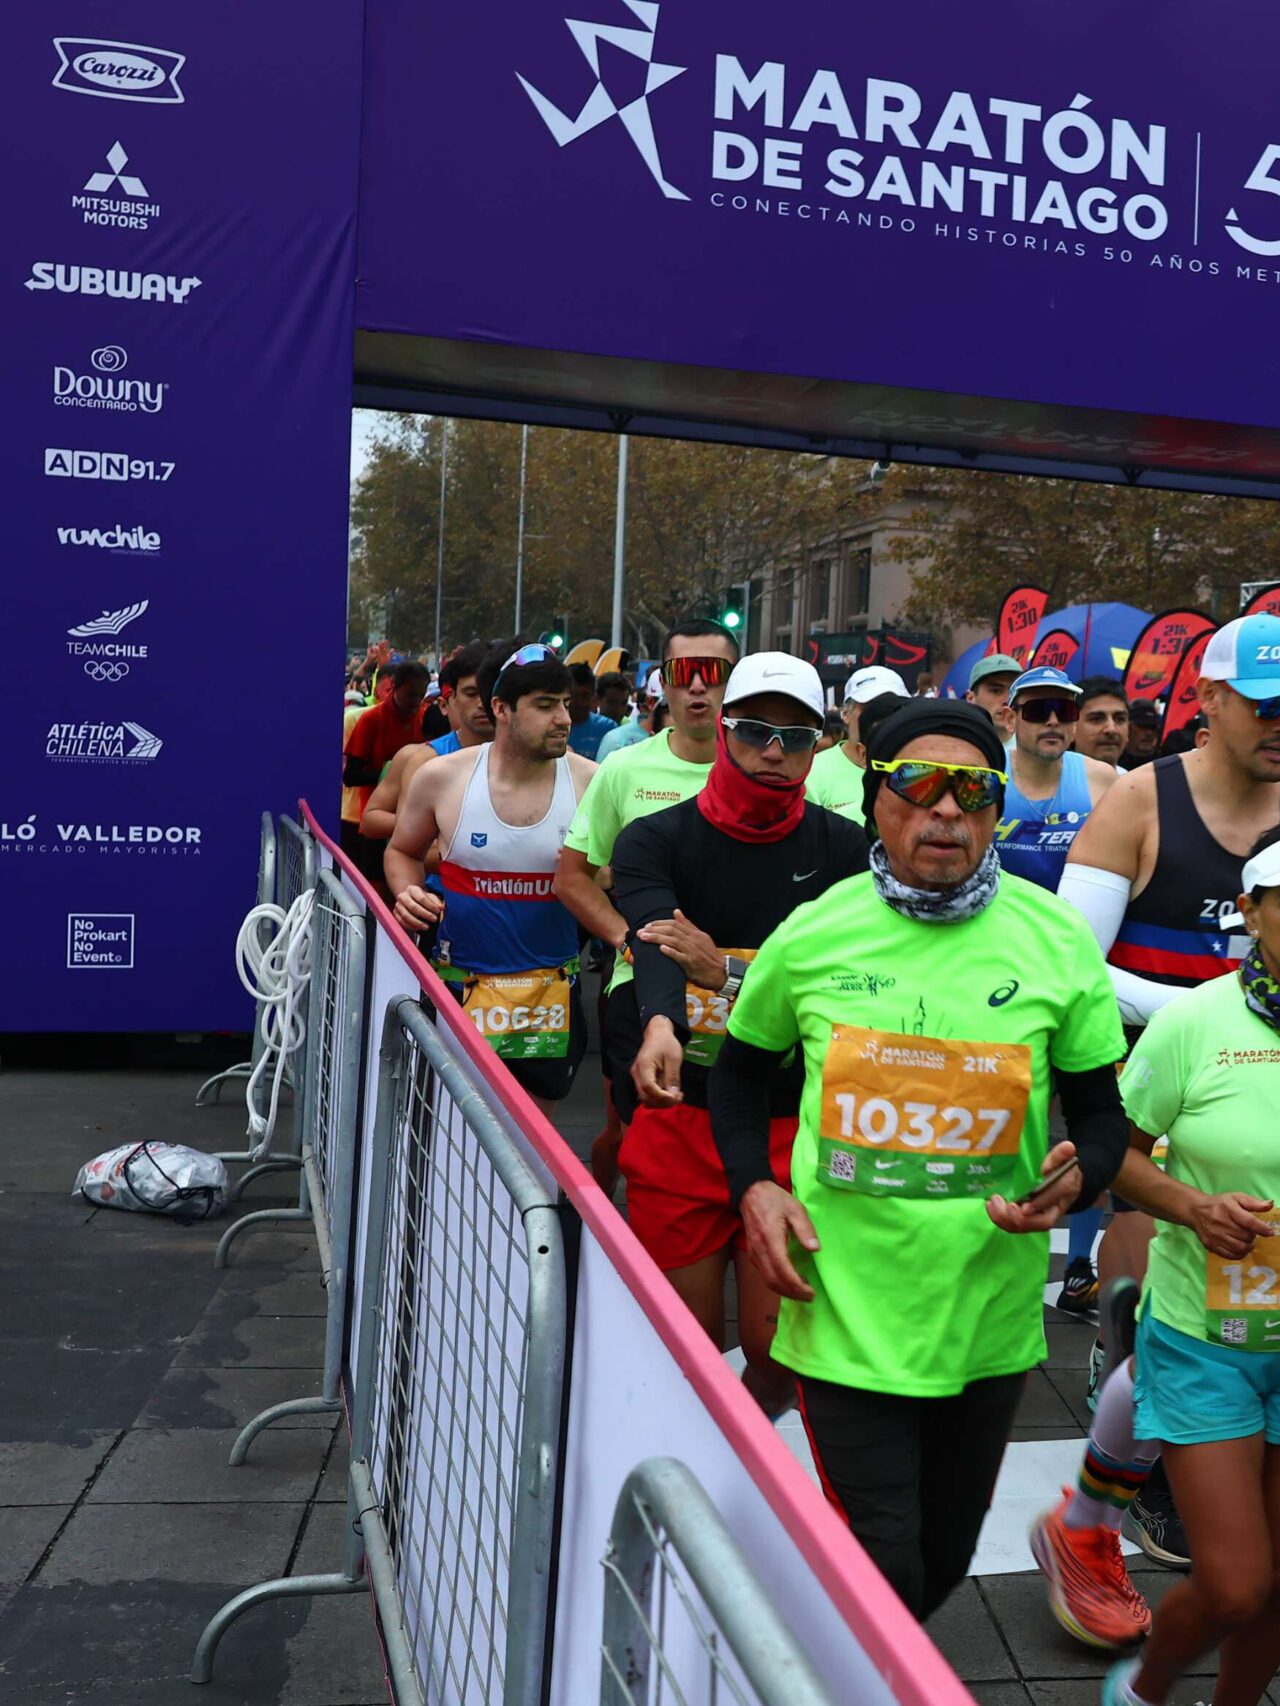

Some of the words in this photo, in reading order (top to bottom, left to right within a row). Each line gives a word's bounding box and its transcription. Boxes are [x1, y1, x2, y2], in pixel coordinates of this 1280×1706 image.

[78, 57, 159, 83] Carozzi
[713, 53, 1166, 187] MARATÓN
[711, 130, 803, 190] DE
[823, 148, 1169, 241] SANTIAGO
[72, 195, 160, 217] MITSUBISHI
[84, 211, 148, 230] MOTORS
[710, 192, 917, 232] CONECTANDO
[934, 223, 1087, 257] HISTORIAS
[1103, 247, 1133, 263] 50
[1150, 253, 1220, 275] AÑOS
[24, 261, 203, 304] SUBWAY
[54, 366, 164, 413] Downy
[54, 396, 137, 412] CONCENTRADO
[46, 450, 128, 480] ADN
[130, 459, 176, 481] 91.7
[57, 524, 161, 551] runchile
[1007, 608, 1038, 633] 1:30
[66, 641, 148, 658] TEAMCHILE
[46, 739, 124, 757] CHILENA
[57, 824, 202, 844] VALLEDOR
[1, 844, 86, 853] MERCADO
[100, 846, 201, 855] MAYORISTA
[473, 876, 534, 896] Triatlón
[74, 919, 94, 930] No
[74, 929, 128, 941] Prokart
[74, 941, 94, 952] No
[470, 1004, 565, 1033] 10628
[962, 1055, 998, 1074] 21K
[834, 1092, 1012, 1151] 10327
